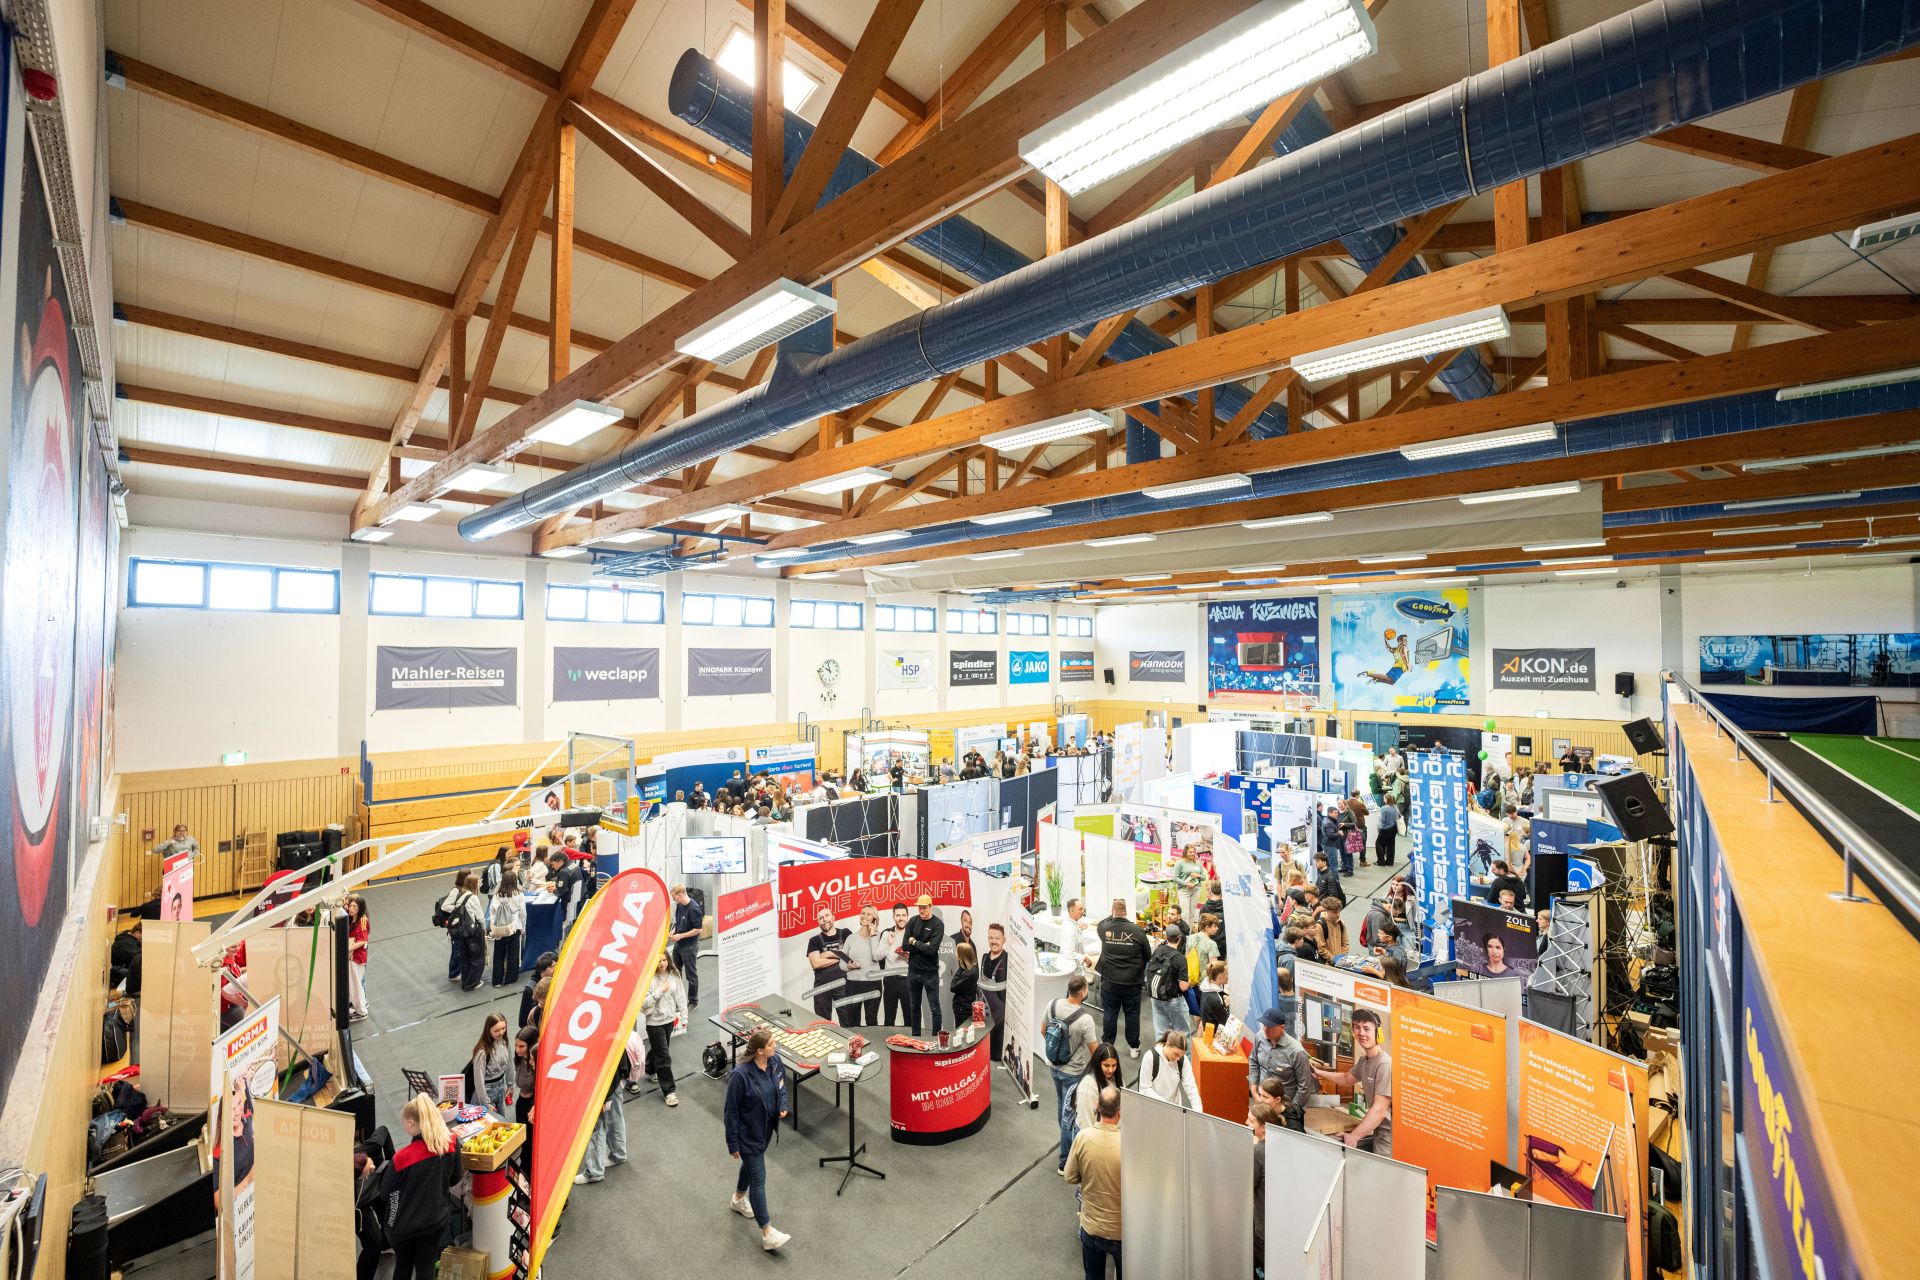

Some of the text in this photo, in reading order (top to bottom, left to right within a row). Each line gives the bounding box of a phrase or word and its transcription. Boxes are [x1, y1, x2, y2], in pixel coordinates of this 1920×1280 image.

[1209, 602, 1317, 622] ARENA KITZINGEN
[1412, 603, 1449, 615] GOODYEAR
[391, 666, 505, 680] Mahler-Reisen
[698, 666, 763, 674] INNOPARK Kitzingen
[902, 664, 920, 676] HSP
[953, 660, 994, 669] spindler
[1024, 660, 1048, 673] JAKO
[585, 667, 648, 682] weclapp
[1532, 675, 1546, 683] mit
[1547, 675, 1589, 684] Zuschuss
[515, 818, 534, 829] SAM
[807, 864, 916, 902] VOLLGAS
[724, 901, 759, 920] MIT VOLLGAS
[780, 880, 964, 930] IN DIE ZUKUNFT!
[1506, 915, 1531, 928] ZOLL
[547, 890, 655, 1082] NORMA
[1400, 1015, 1453, 1035] Schreinerlehre
[231, 1023, 265, 1053] NORMA
[1408, 1039, 1435, 1053] Lehrjahr
[934, 1049, 977, 1067] spindler
[1528, 1050, 1586, 1081] Schreinerlehre
[1408, 1074, 1420, 1082] und
[1428, 1080, 1456, 1095] Lehrjahr
[1528, 1060, 1595, 1093] das ist dein Ding!
[911, 1071, 977, 1102] MIT VOLLGAS
[1528, 1074, 1596, 1110] Dein Gesellenstück
[921, 1100, 934, 1111] IN
[935, 1095, 954, 1109] DIE
